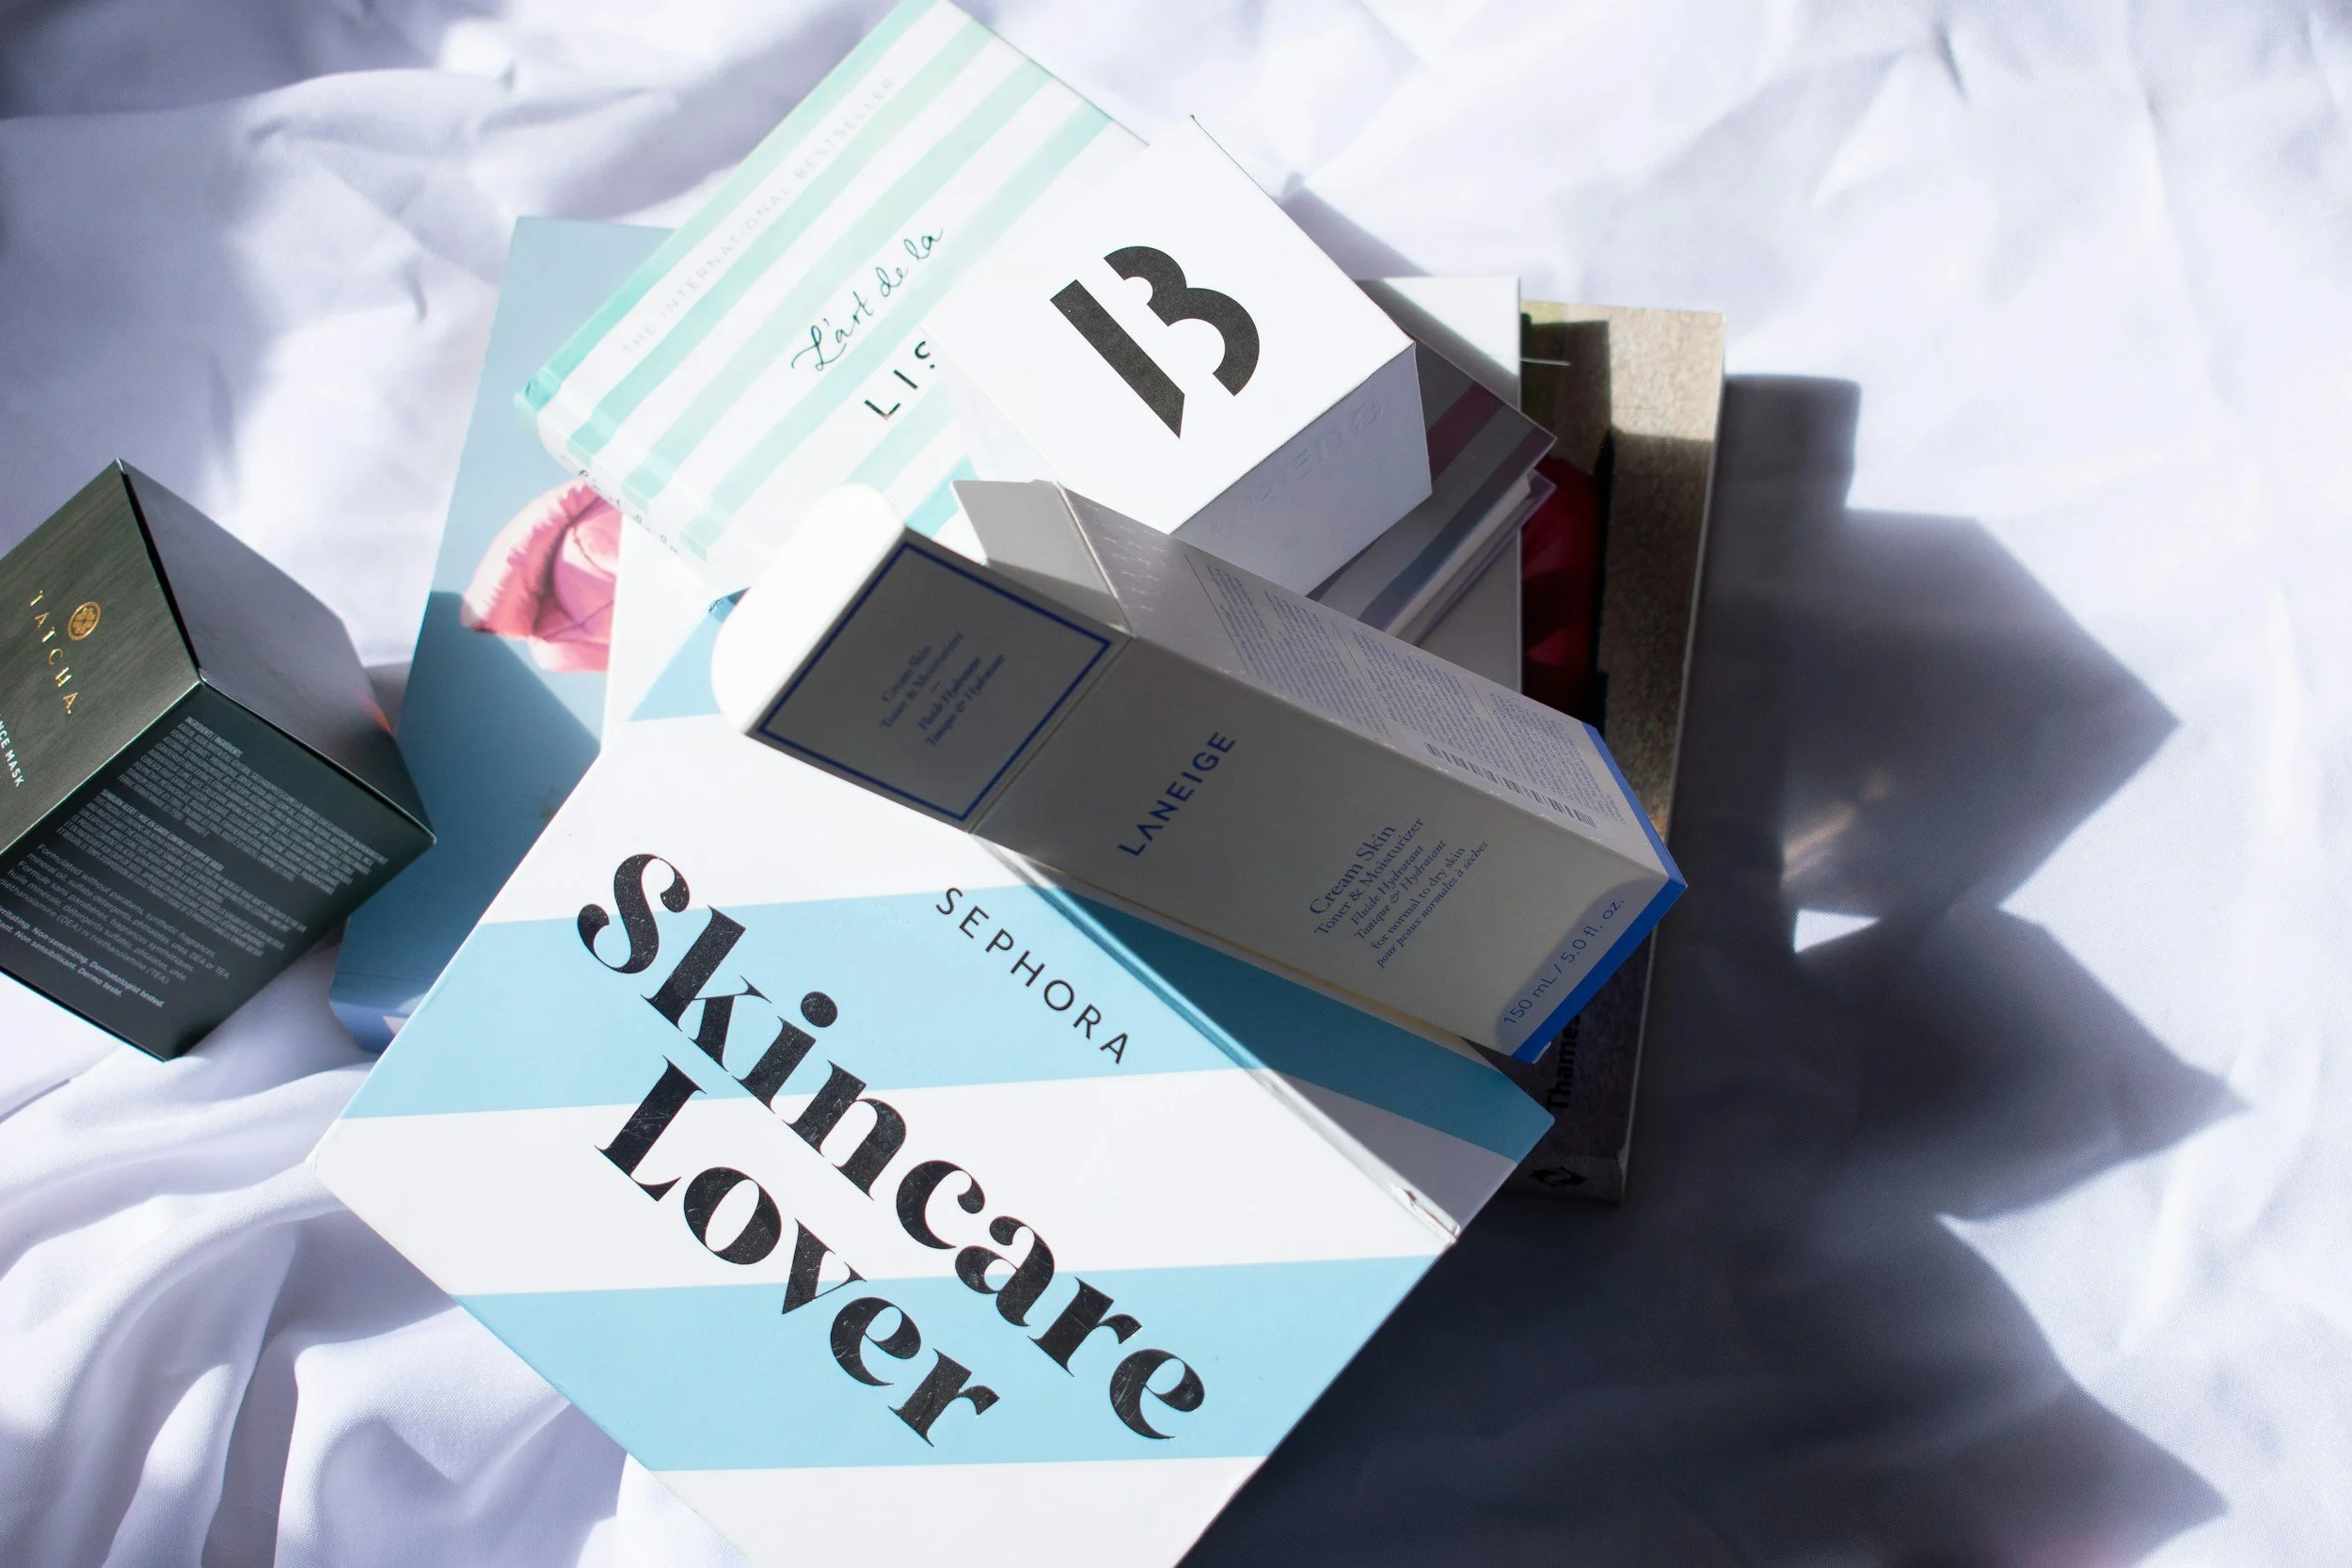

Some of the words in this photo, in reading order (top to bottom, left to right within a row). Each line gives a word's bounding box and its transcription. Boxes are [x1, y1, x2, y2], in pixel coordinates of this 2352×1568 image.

[660, 186, 793, 319] INTERNATIONAL
[793, 77, 894, 181] BESTSELLER
[791, 291, 874, 371] L'art
[876, 266, 909, 297] de
[904, 227, 944, 261] la
[1050, 245, 1260, 438] B
[5, 749, 24, 786] MASK
[1118, 732, 1236, 856] LANEIGE
[17, 860, 52, 885] Formule
[49, 881, 70, 896] sans
[26, 852, 57, 874] mineral
[37, 843, 84, 875] Formulated
[80, 873, 112, 893] without
[1310, 863, 1363, 914] Cream
[1356, 826, 1397, 862] Skin
[1314, 901, 1351, 935] Toner
[1349, 888, 1365, 902] &
[1359, 817, 1424, 888] Moisturizer
[1350, 894, 1380, 926] Fluide
[1377, 845, 1424, 895] Hydratant
[1354, 903, 1391, 940] Tonique
[1390, 890, 1400, 904] &
[1400, 839, 1446, 891] Hydratant
[1371, 934, 1389, 950] for
[1387, 897, 1421, 934] normal
[1419, 886, 1431, 899] to
[1428, 868, 1448, 887] dry
[1445, 847, 1466, 868] skin
[13, 929, 32, 943] Non
[1376, 943, 1397, 969] pour
[1395, 918, 1422, 947] peaux
[1421, 876, 1458, 918] normales
[1503, 998, 1533, 1023] 150
[1532, 976, 1557, 997] mL
[1553, 962, 1563, 974] /
[1560, 939, 1587, 963] 5.0
[1582, 925, 1603, 938] fl.
[1602, 900, 1625, 920] oz.
[936, 887, 1130, 1064] SEPHORA
[577, 853, 1205, 1440] Skincare
[595, 1055, 1000, 1448] Lover
